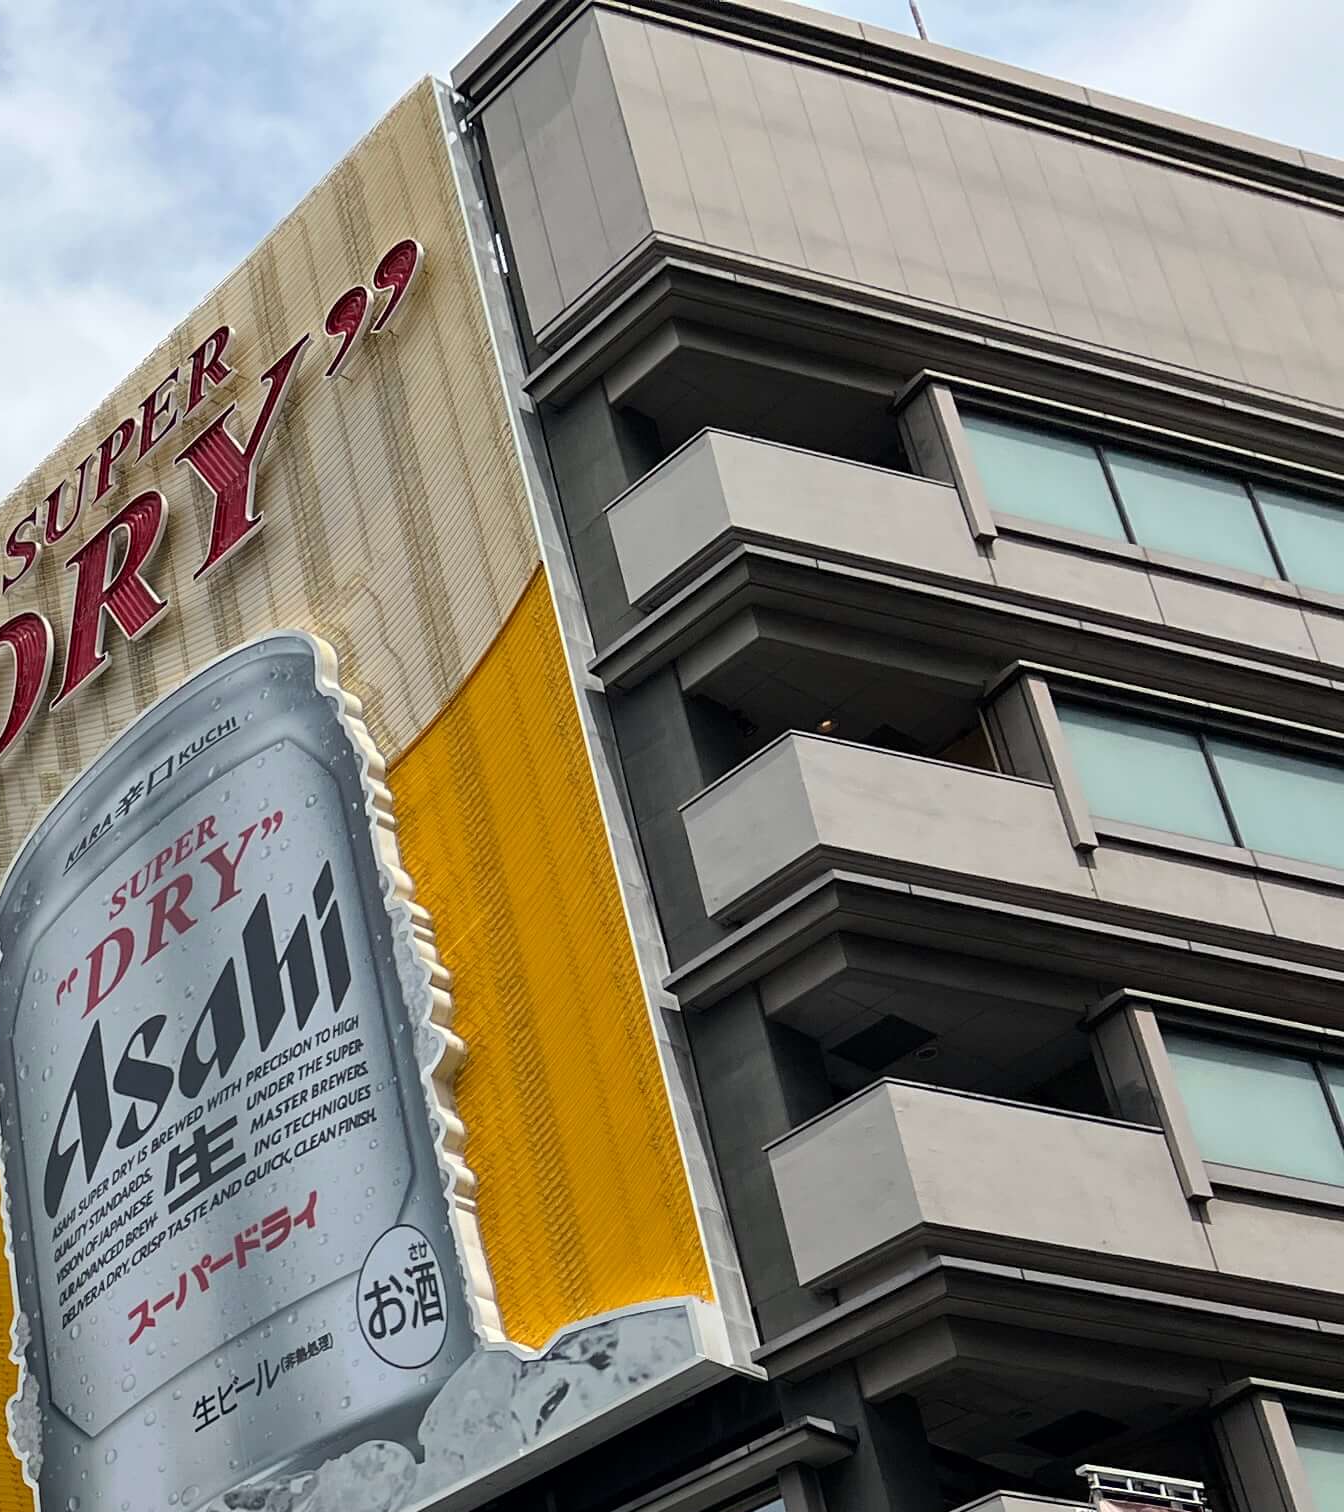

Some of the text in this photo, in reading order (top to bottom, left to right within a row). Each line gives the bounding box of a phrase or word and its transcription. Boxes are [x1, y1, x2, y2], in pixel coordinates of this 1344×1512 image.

[2, 324, 234, 594] SUPER
[176, 715, 240, 769] KUCHI
[114, 755, 173, 818] 辛口
[64, 815, 114, 876] KARA
[109, 814, 217, 921] SUPER
[44, 860, 352, 1218] Asahi
[246, 1076, 294, 1111] UNDER
[296, 1061, 322, 1085] THE
[250, 1091, 308, 1134] MASTER
[253, 1084, 372, 1158] ING TECHNIQUES
[51, 1015, 360, 1243] ASAHI SUPER DRY IS BREWED WITH PRECISION TO HIGH
[163, 1115, 247, 1215] 生
[54, 1220, 89, 1263] QUALITY
[56, 1247, 85, 1284] VISION
[97, 1189, 154, 1250] JAPANESE
[61, 1285, 98, 1330] DELIVER
[131, 1231, 166, 1269] CRISP
[167, 1207, 209, 1243] TASTE
[209, 1181, 242, 1211] AND
[293, 1128, 336, 1162] CLEAN
[75, 1238, 124, 1288] ADVANCED
[128, 1189, 318, 1345] スーパードライ
[364, 1262, 444, 1340] お酒
